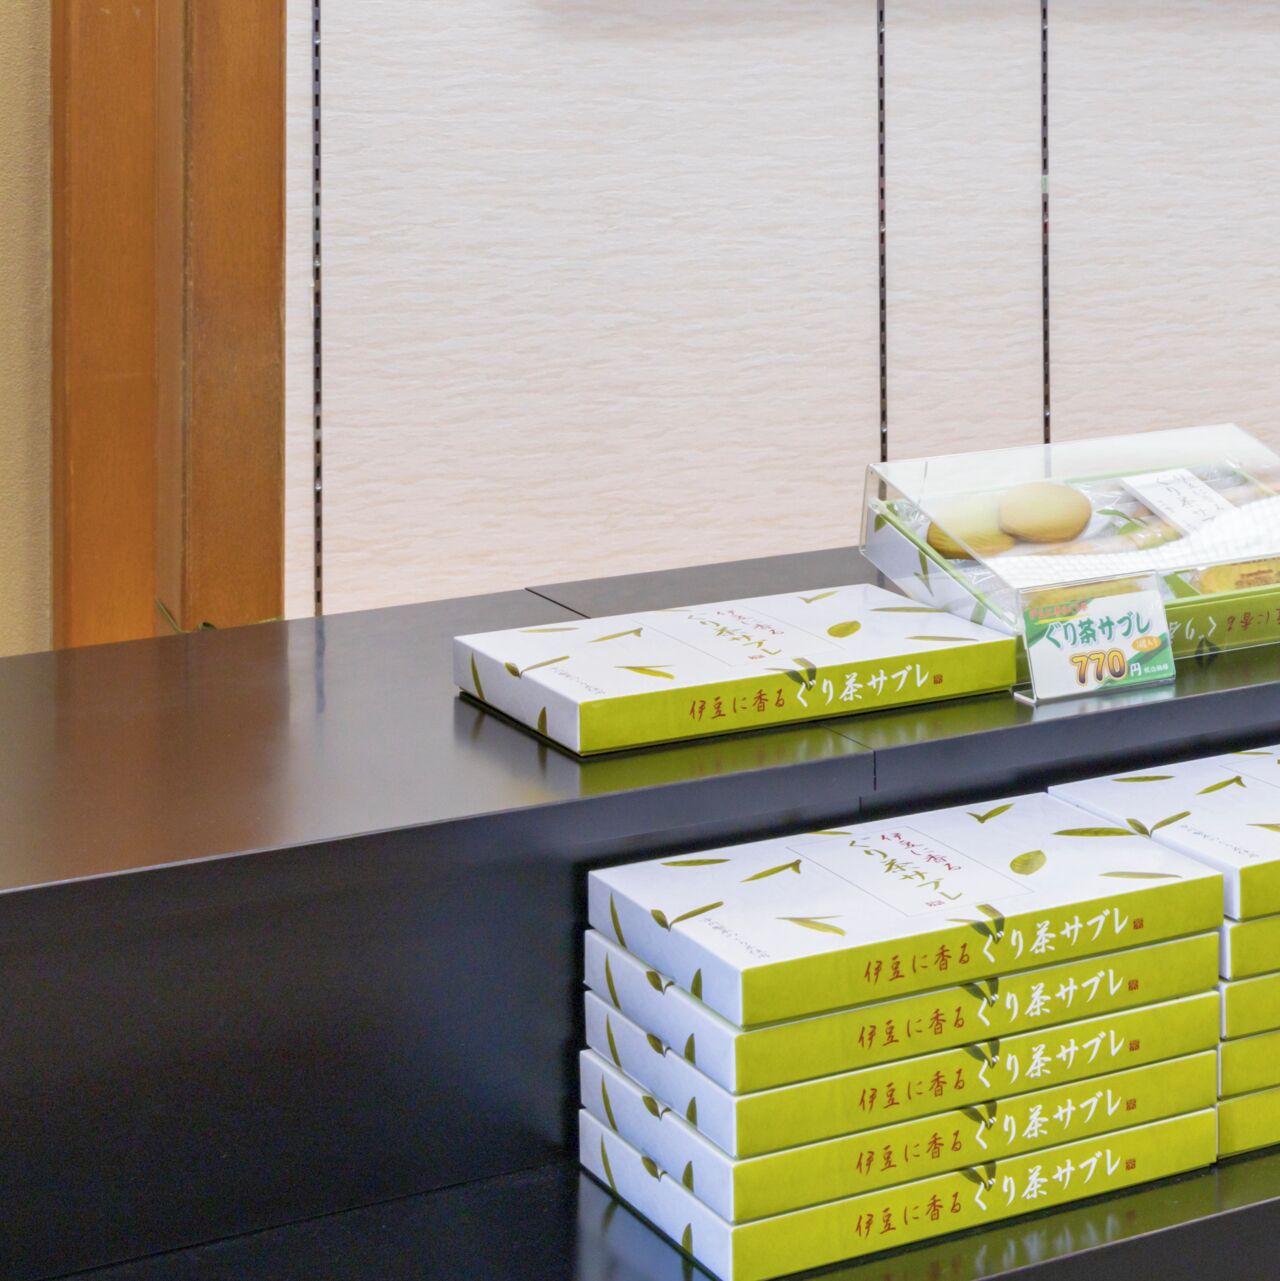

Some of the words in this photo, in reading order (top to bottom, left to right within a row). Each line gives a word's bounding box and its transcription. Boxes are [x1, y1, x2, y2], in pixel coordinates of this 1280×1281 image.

[1044, 612, 1151, 649] ぐり茶サブレ
[690, 688, 784, 717] 伊豆に香る
[797, 665, 928, 706] ぐり茶サブレ
[865, 944, 969, 979] 伊豆に香る
[983, 907, 1129, 965] ぐり茶サブレ
[859, 1007, 963, 1045] 伊豆に香る
[977, 968, 1123, 1023] ぐり茶サブレ
[860, 1069, 964, 1108] 伊豆に香る
[977, 1030, 1123, 1088] ぐり茶サブレ
[857, 1131, 960, 1169] 伊豆に香る
[974, 1089, 1121, 1148] ぐり茶サブレ
[856, 1192, 960, 1233] 伊豆に香る
[973, 1150, 1120, 1210] ぐり茶サブレ
